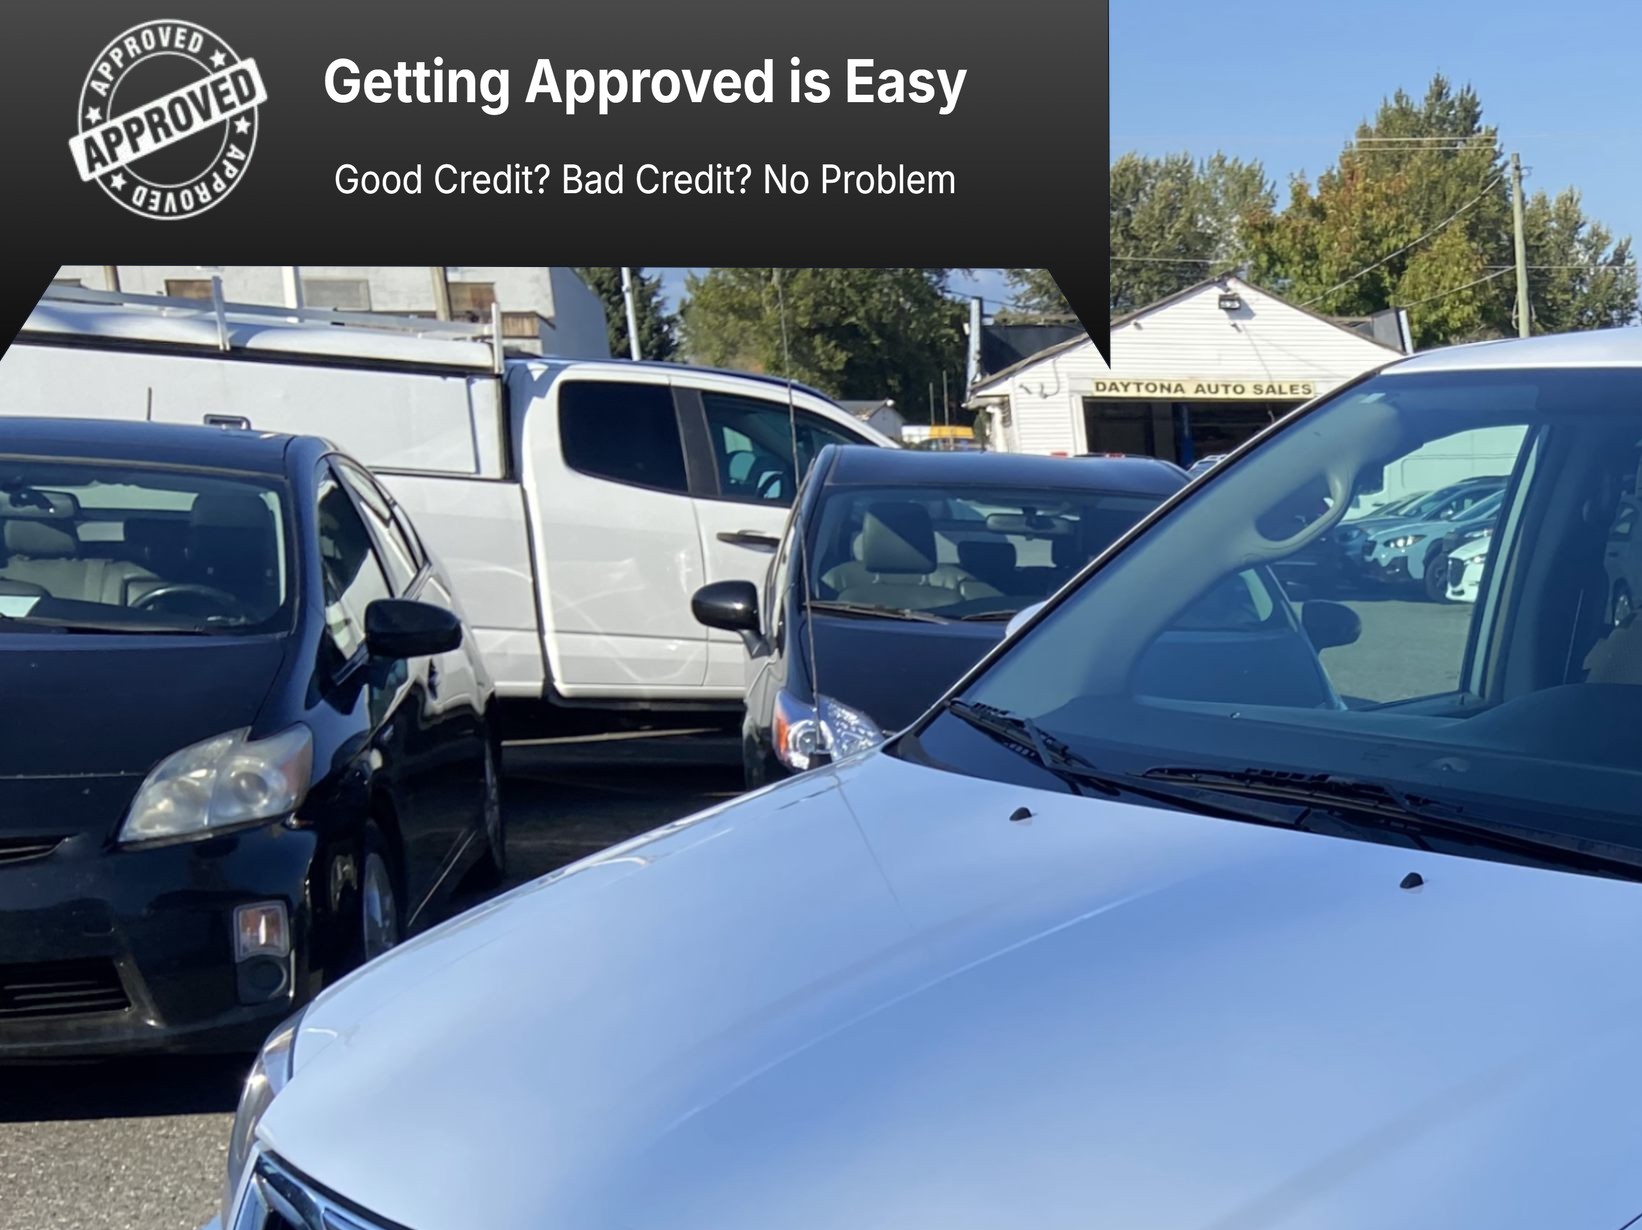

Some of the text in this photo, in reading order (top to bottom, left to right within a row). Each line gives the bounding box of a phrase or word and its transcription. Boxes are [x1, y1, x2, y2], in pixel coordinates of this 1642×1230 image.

[1095, 381, 1313, 396] DAYTONA AUTO SALES
